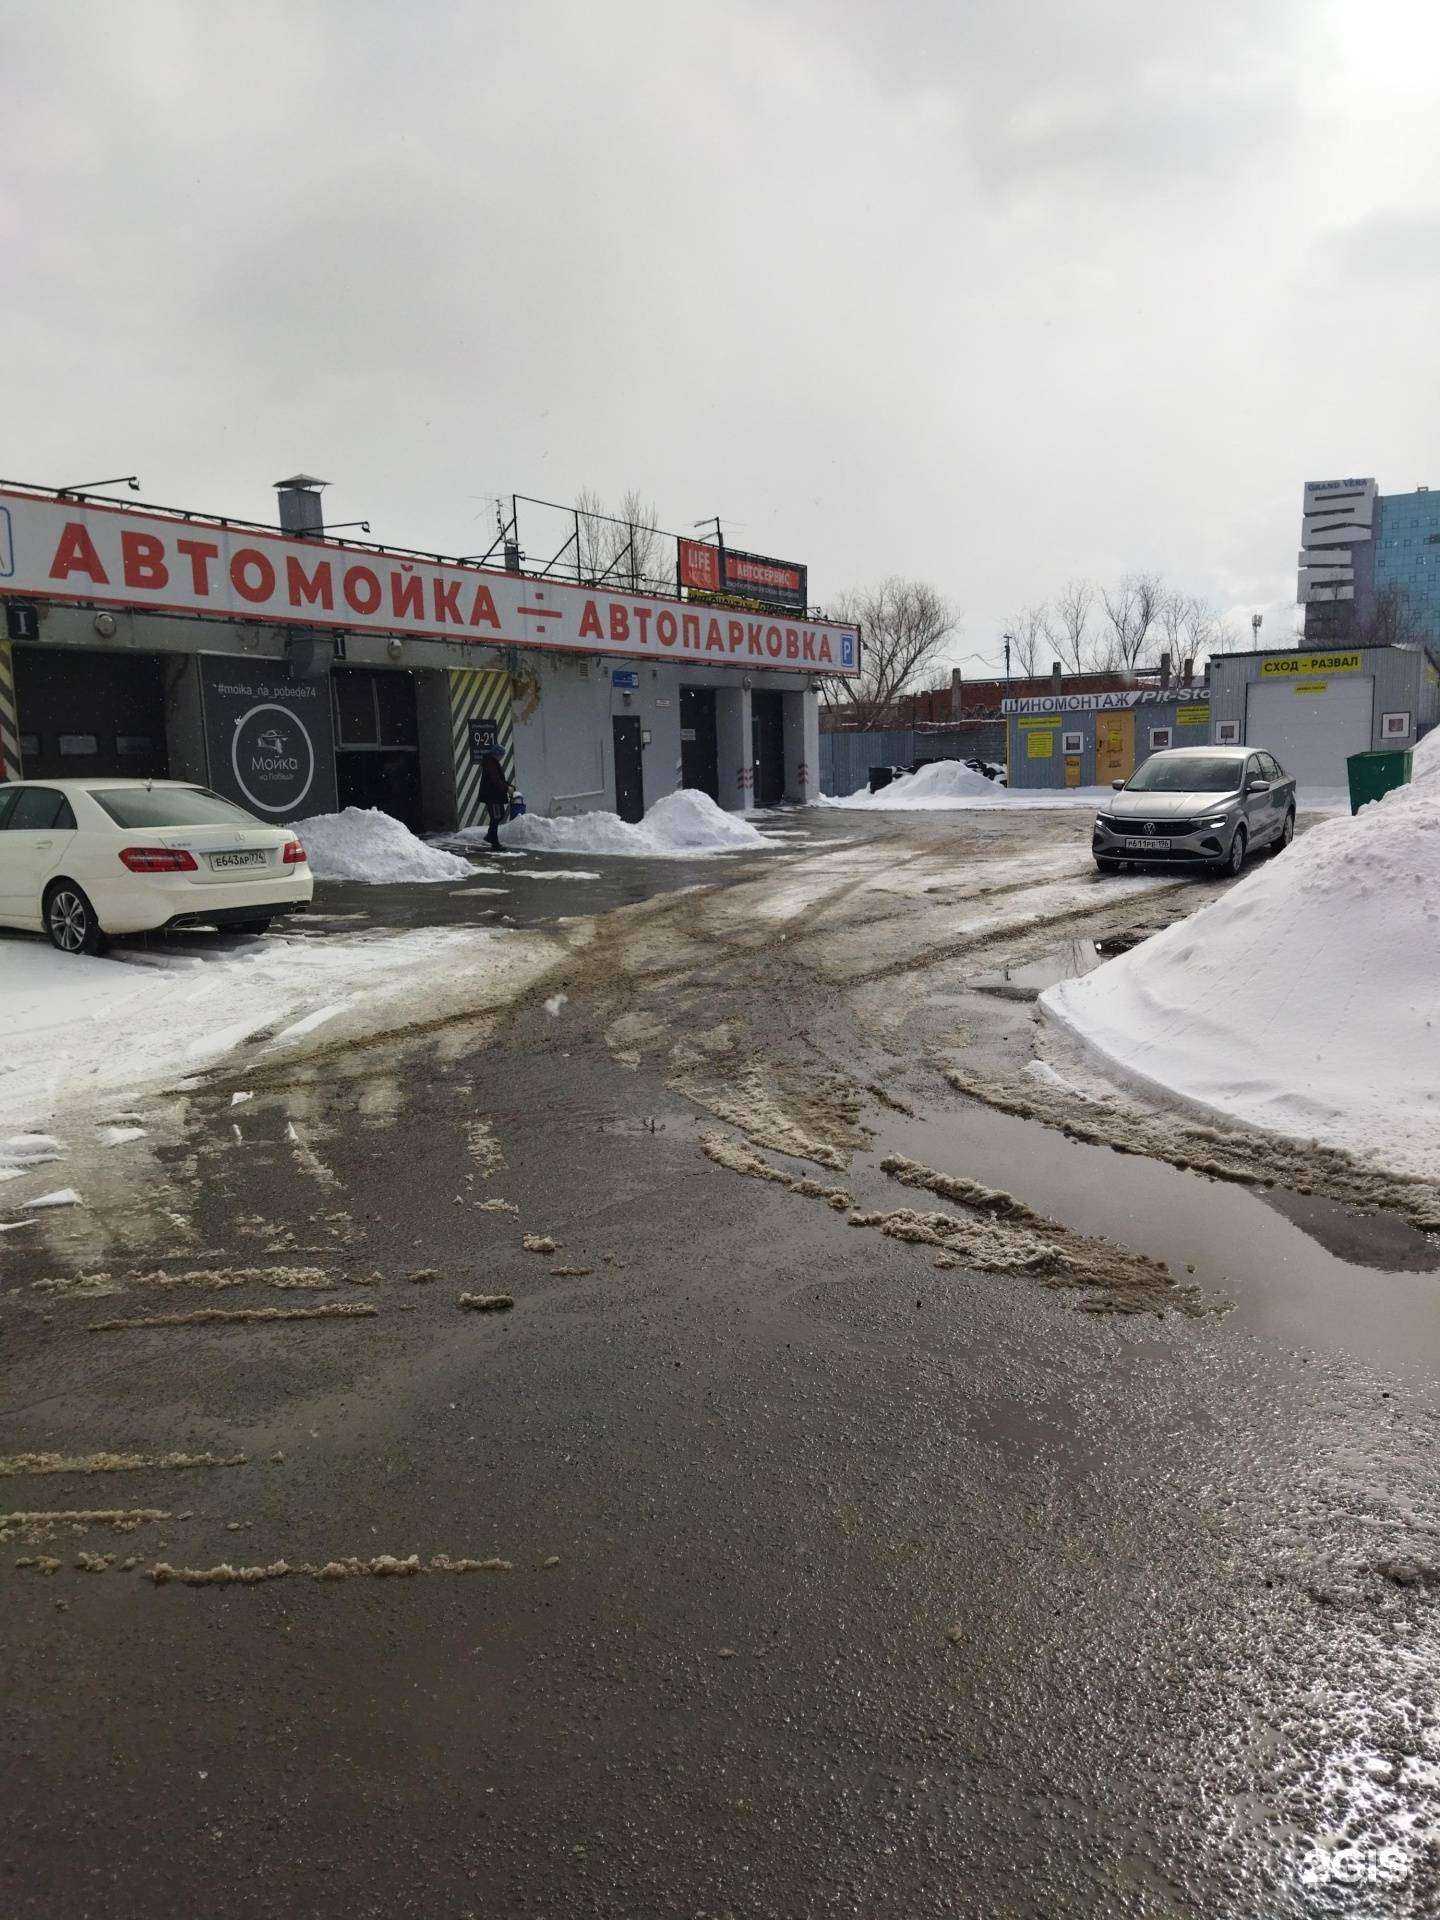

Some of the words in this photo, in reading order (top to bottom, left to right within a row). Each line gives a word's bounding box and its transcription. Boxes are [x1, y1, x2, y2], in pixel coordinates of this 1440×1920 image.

[736, 563, 791, 584] АВТОСЕРВИС
[49, 521, 502, 629] АВТОМОЙКА
[578, 600, 833, 663] АВТОПАРКОВКА
[1264, 661, 1299, 673] СХОД
[1311, 656, 1359, 669] РАЗВАЛ
[1004, 692, 1131, 713] ШИНОМОНТАЖ
[1141, 688, 1212, 703] Pit-Sto
[251, 754, 298, 771] Мойка
